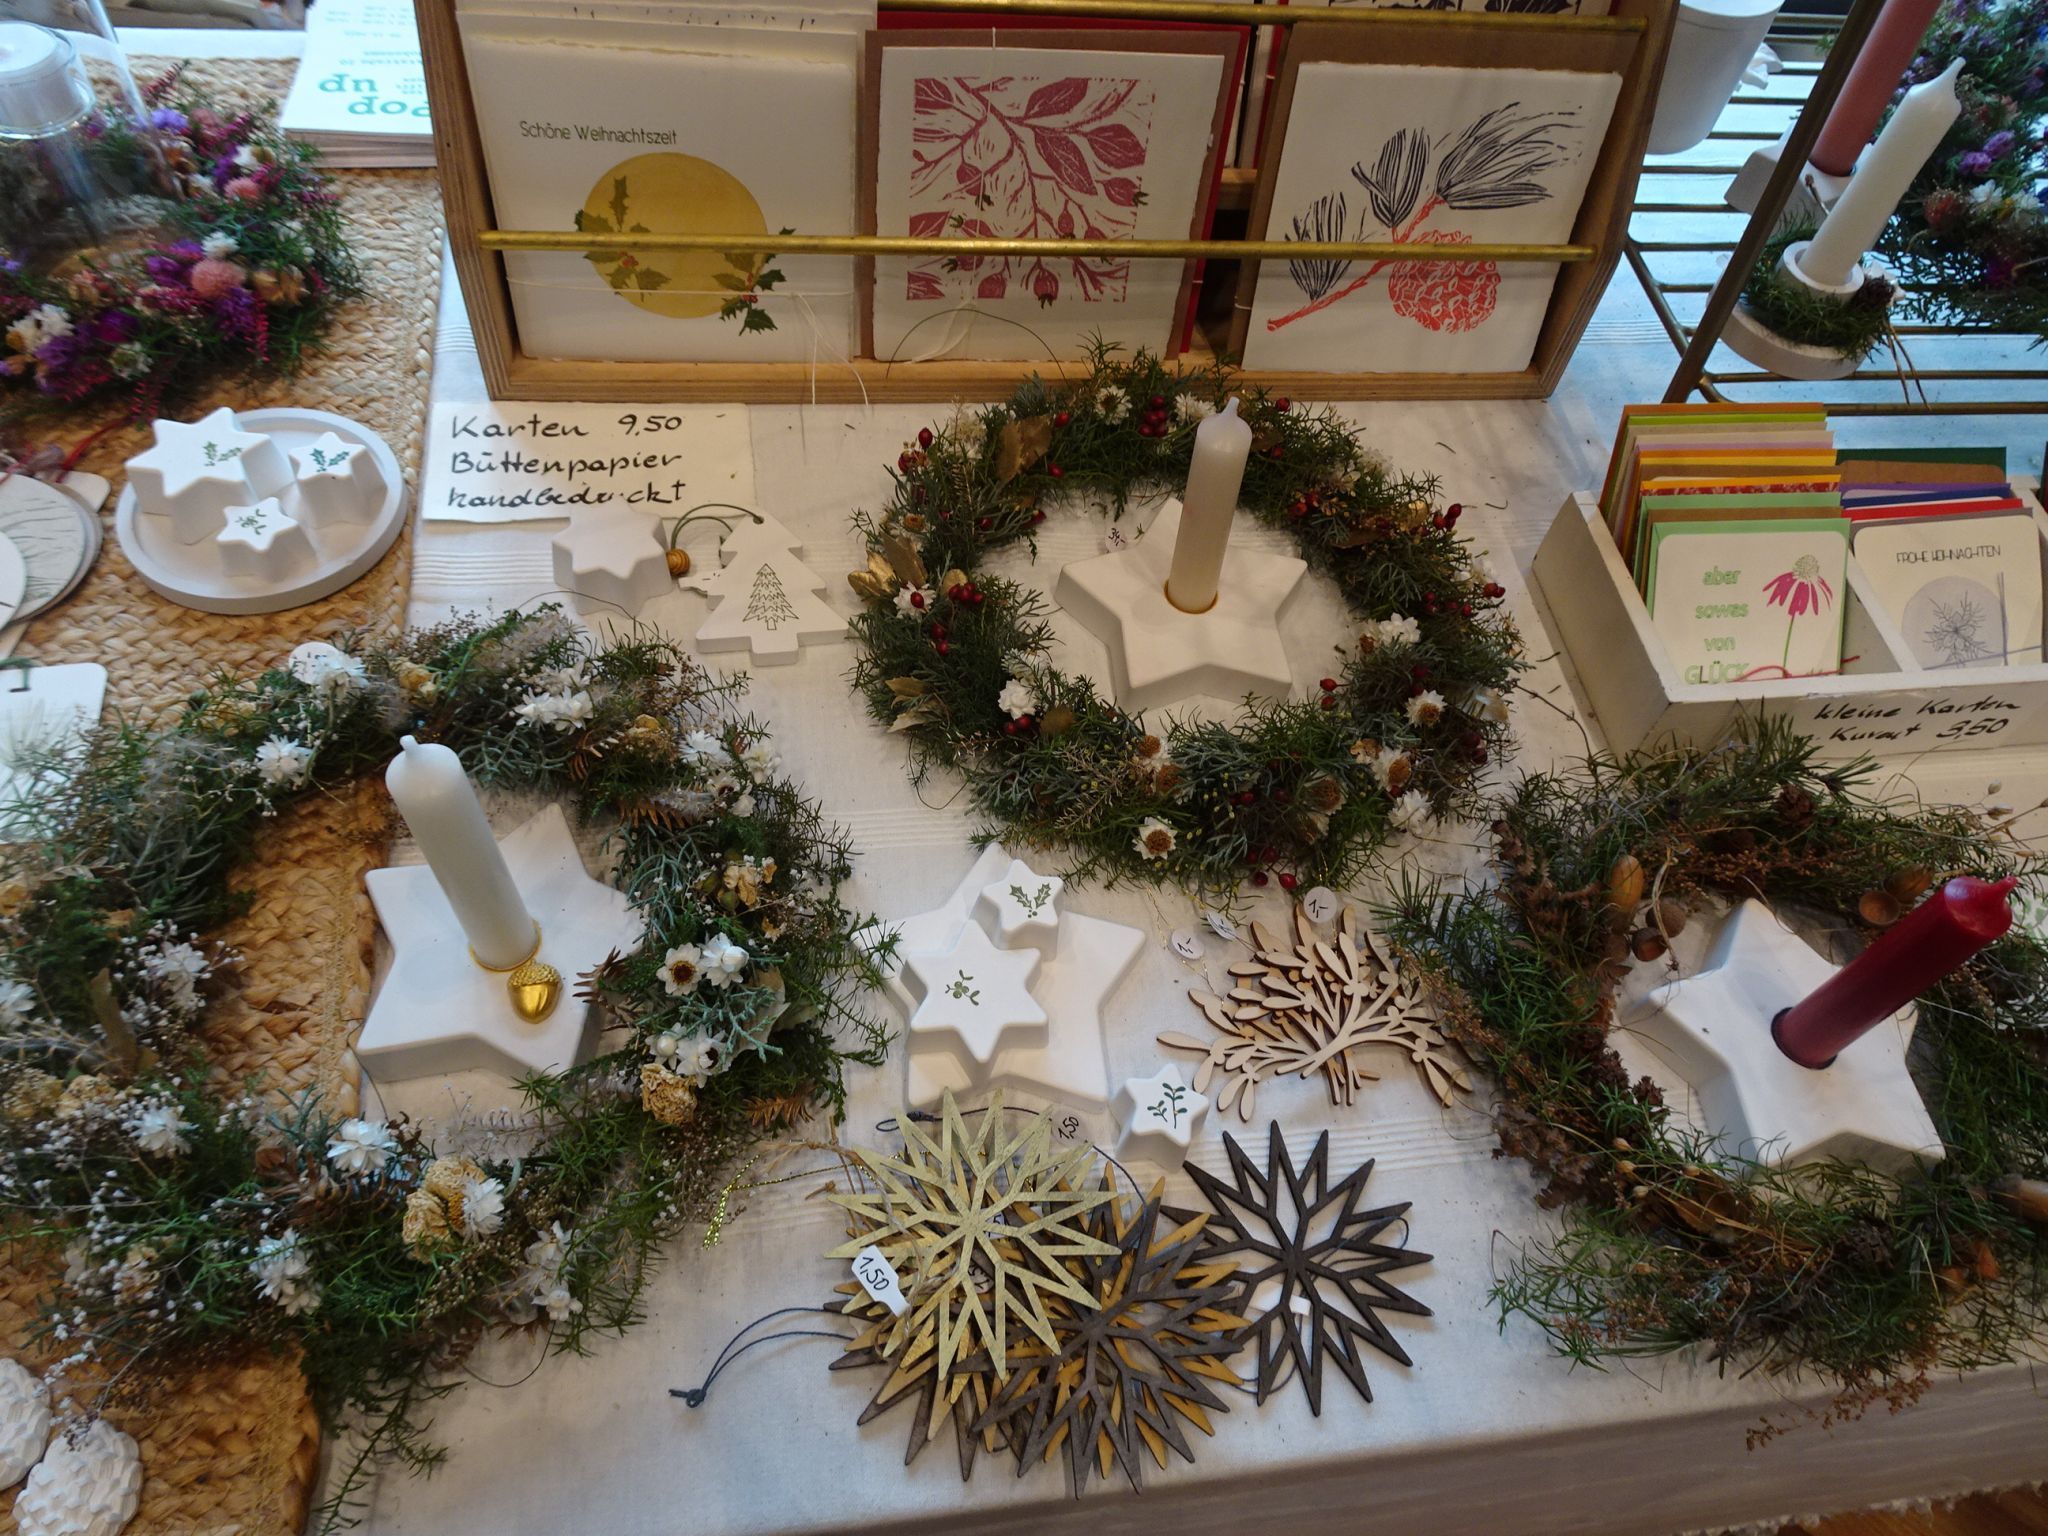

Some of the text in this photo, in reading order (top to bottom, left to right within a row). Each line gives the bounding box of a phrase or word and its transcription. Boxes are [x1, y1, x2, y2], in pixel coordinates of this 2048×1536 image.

[519, 120, 677, 145] Schöne Weihnachtszeit
[452, 413, 589, 438] Karten
[451, 451, 683, 481] Büttenpapier
[1702, 565, 1741, 585] aber
[1695, 603, 1749, 619] sowas
[1703, 637, 1736, 651] von
[1814, 694, 2021, 720] kleine Karten
[859, 1256, 890, 1291] 1,50
